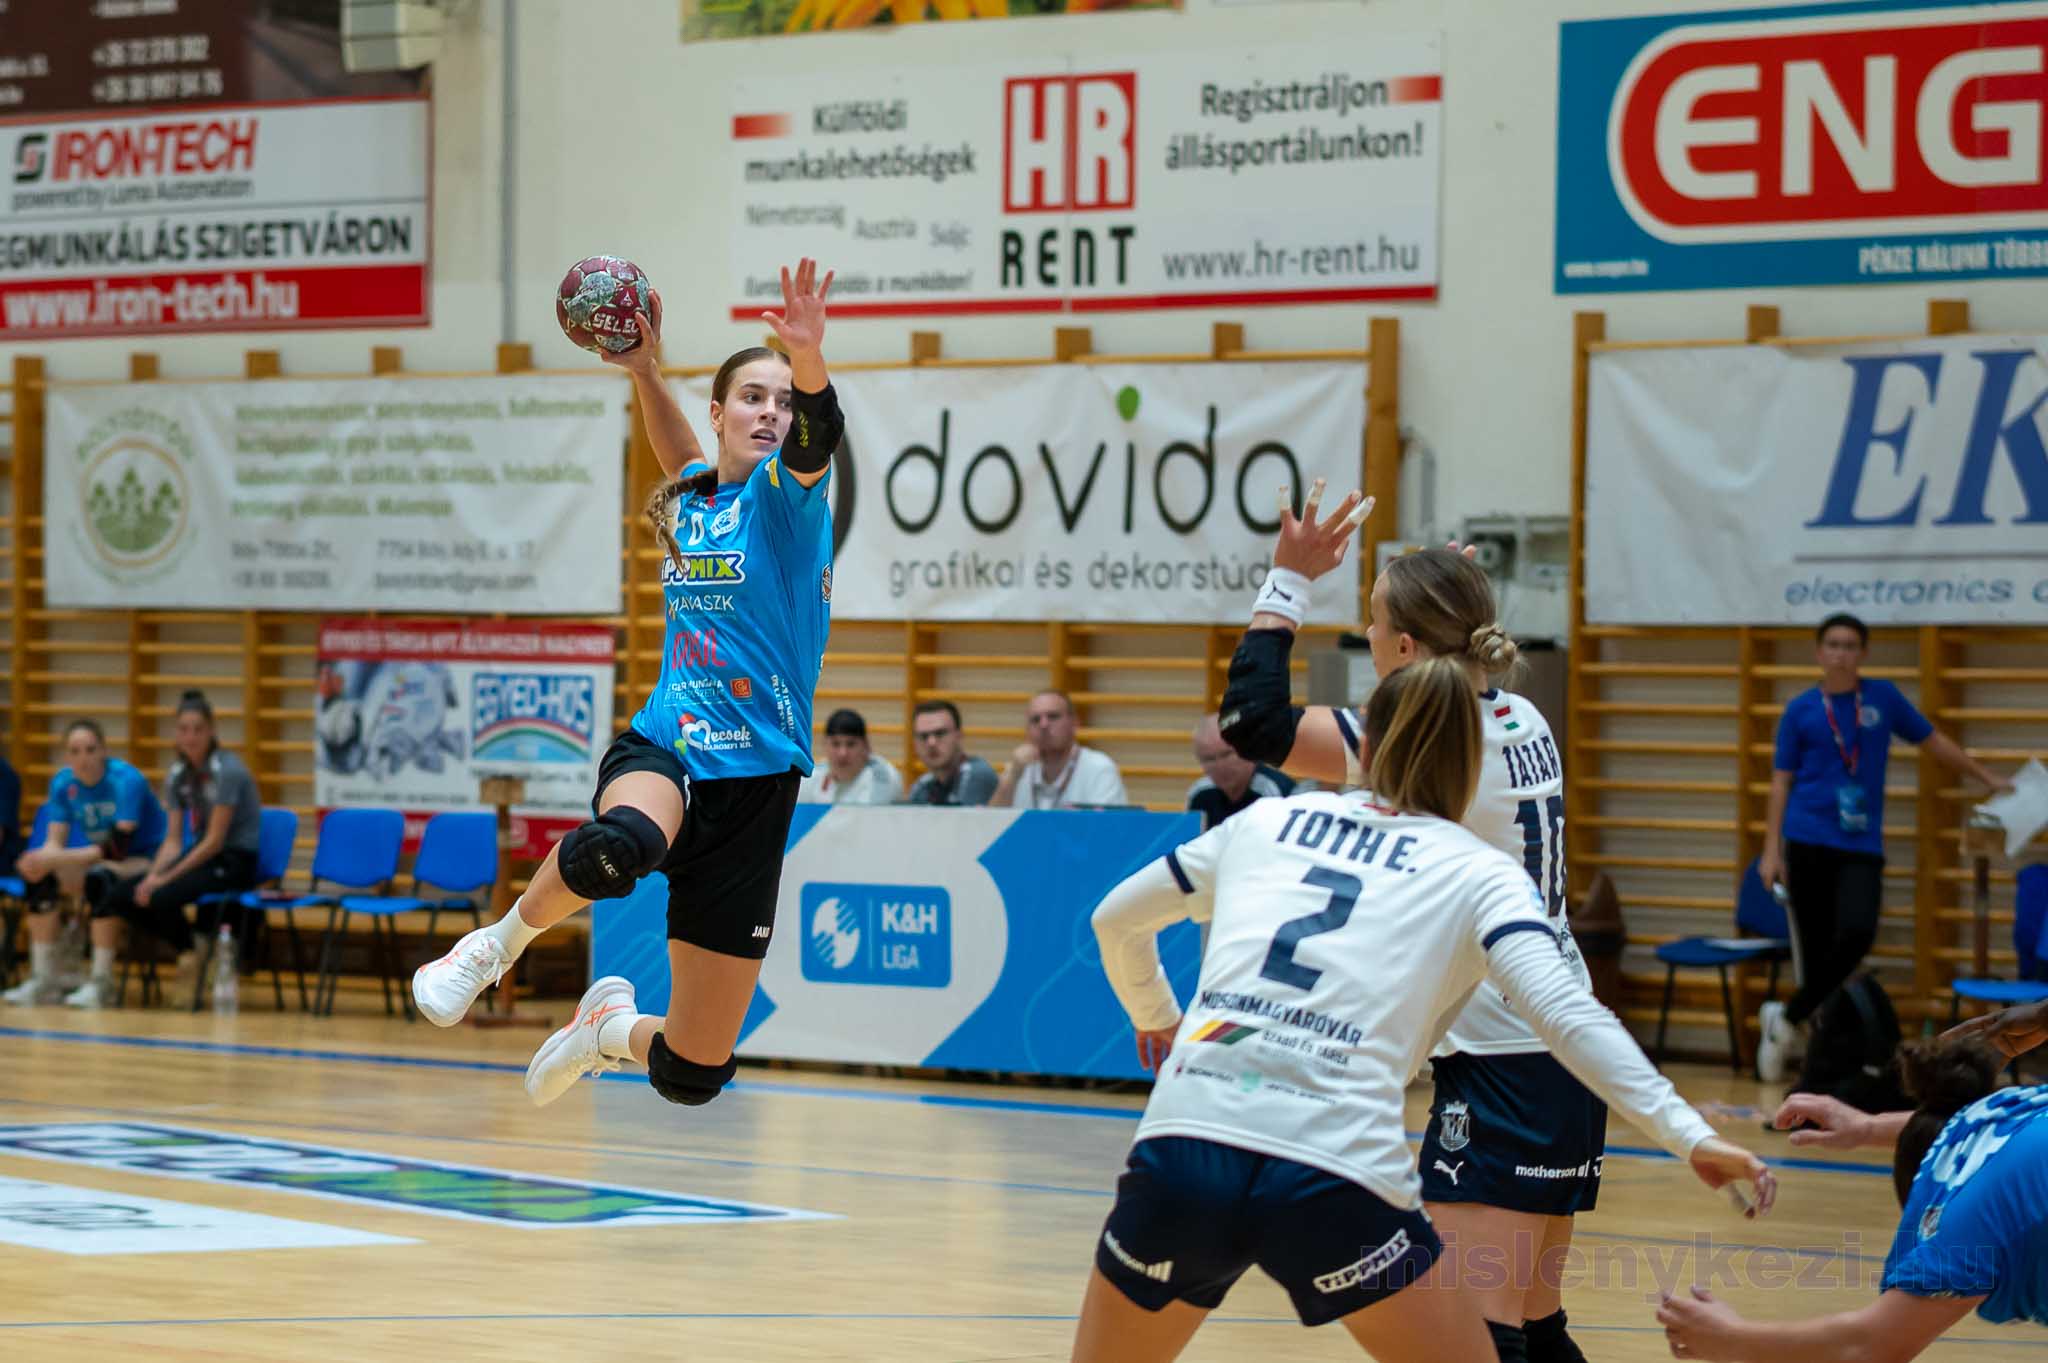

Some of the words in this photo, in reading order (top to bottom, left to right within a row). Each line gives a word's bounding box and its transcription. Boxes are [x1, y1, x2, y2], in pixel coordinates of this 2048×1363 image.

[813, 100, 907, 134] Külföldi
[1201, 75, 1388, 122] Regisztráljon
[1008, 79, 1130, 208] HR
[1654, 46, 2043, 199] ENG
[53, 120, 259, 181] IRON-TECH
[745, 141, 975, 183] munkalehetőségek
[1165, 122, 1424, 173] állásportálunkon!
[196, 211, 411, 261] SZIGETVÁRON
[1000, 227, 1136, 287] RENT
[1163, 237, 1420, 280] www.hr-rent.hu
[1993, 237, 2048, 269] TÖBB
[4, 273, 299, 327] www.iron-tech.hu
[594, 311, 639, 334] SELEC
[663, 555, 740, 580] PPMIX
[890, 550, 1023, 598] grafikai
[1036, 553, 1071, 590] és
[1088, 550, 1272, 590] dekorstúd
[1785, 576, 2014, 605] electronics
[1384, 836, 1418, 873] E.
[881, 903, 938, 935] K&H
[1259, 865, 1363, 991] 2
[881, 943, 920, 971] LIGA
